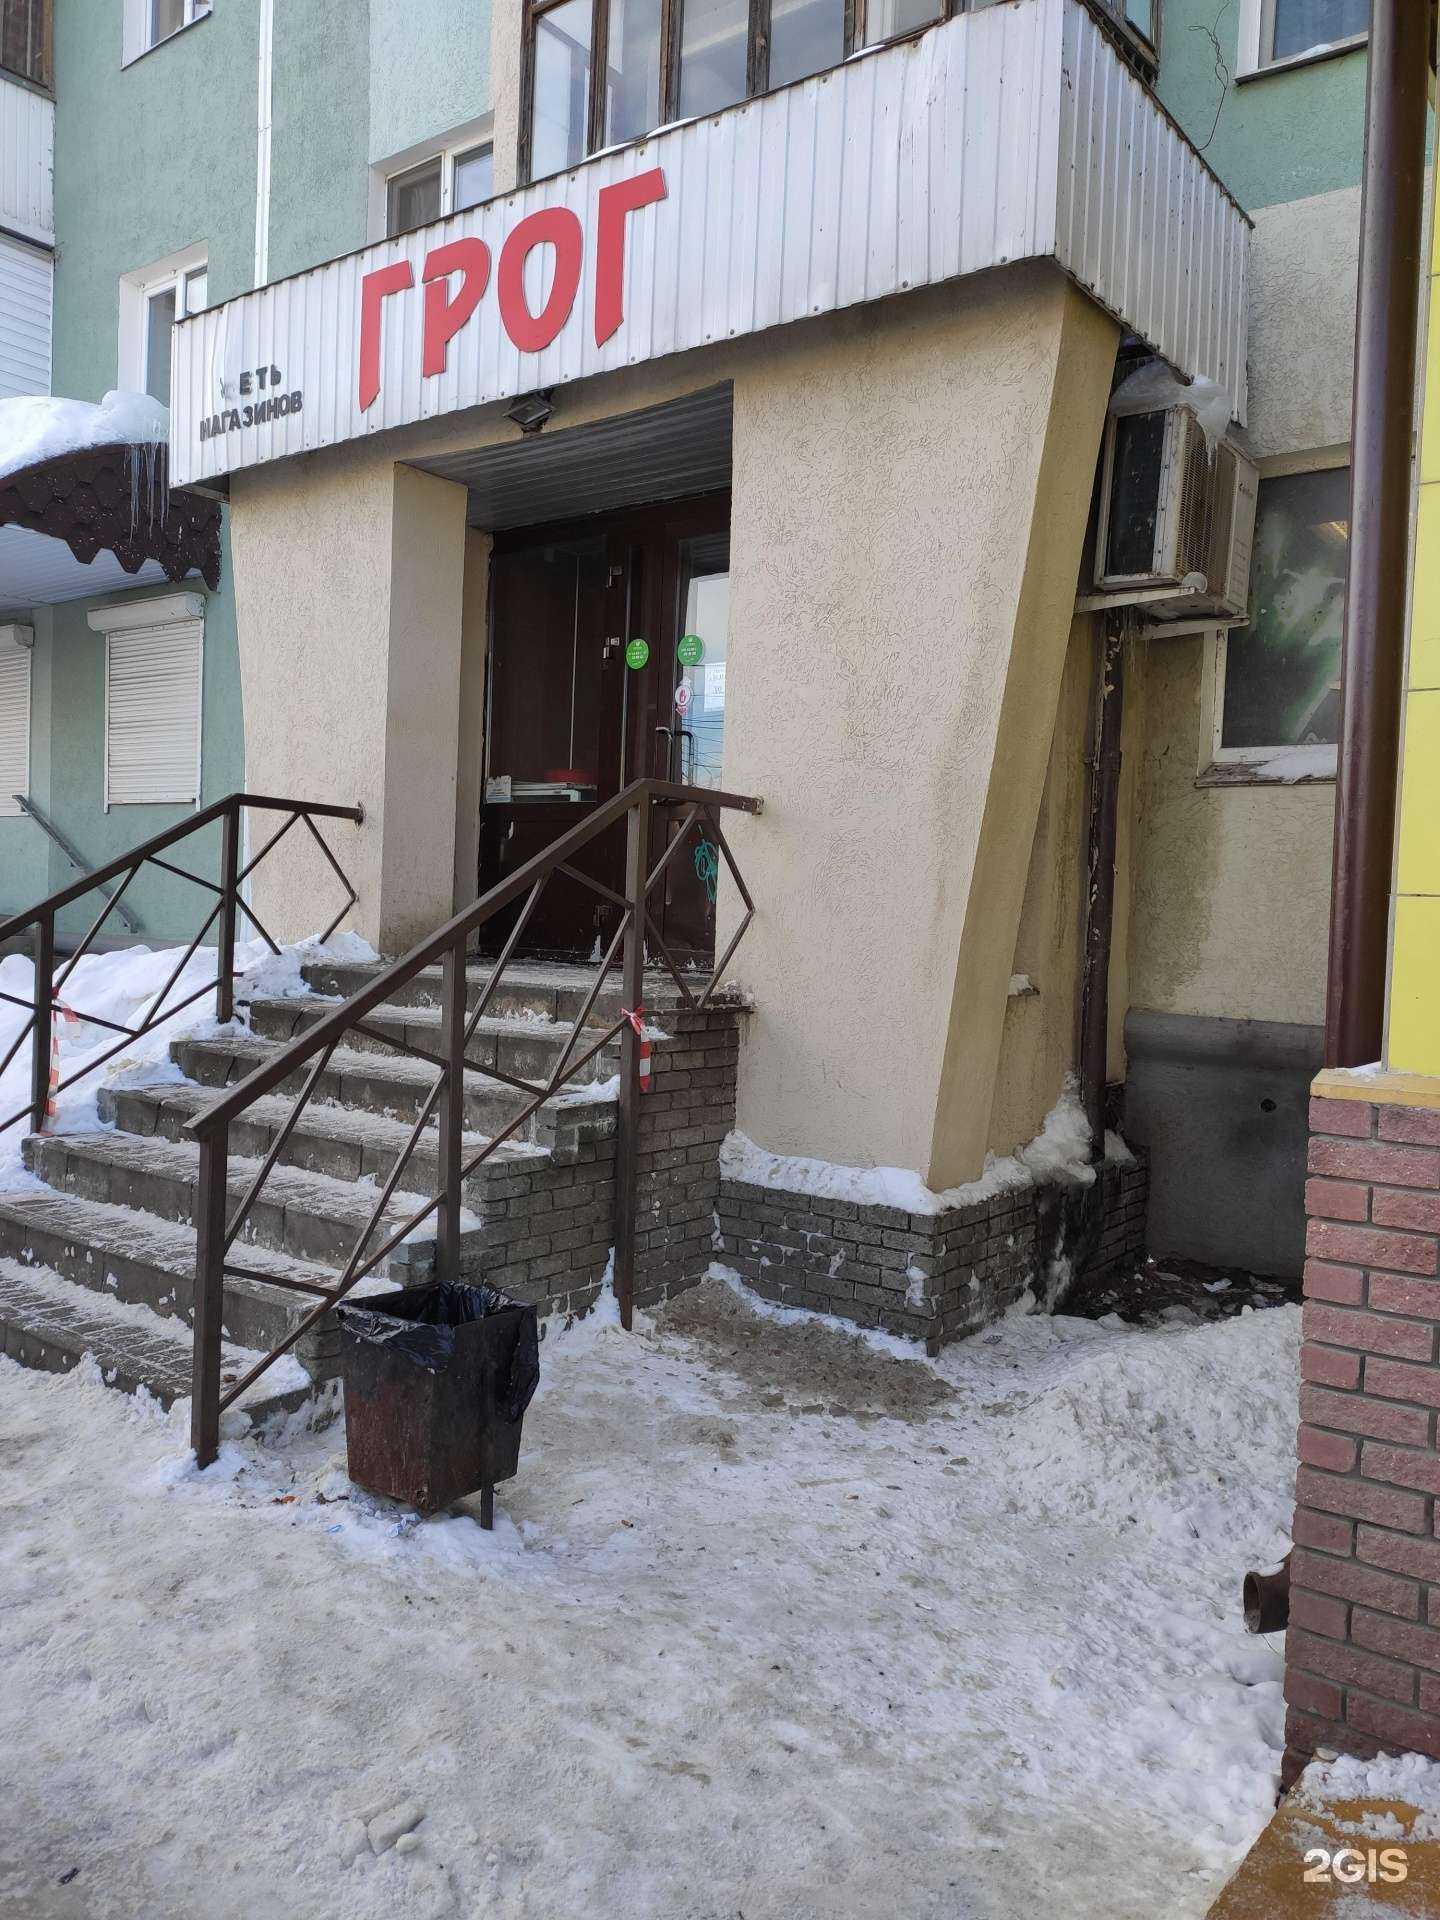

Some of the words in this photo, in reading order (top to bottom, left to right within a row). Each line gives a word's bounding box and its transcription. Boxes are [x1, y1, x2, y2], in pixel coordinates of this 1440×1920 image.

[359, 166, 668, 413] ГРОГ
[219, 364, 281, 398] ЕТЬ
[200, 390, 303, 442] МАГАЗИНОВ
